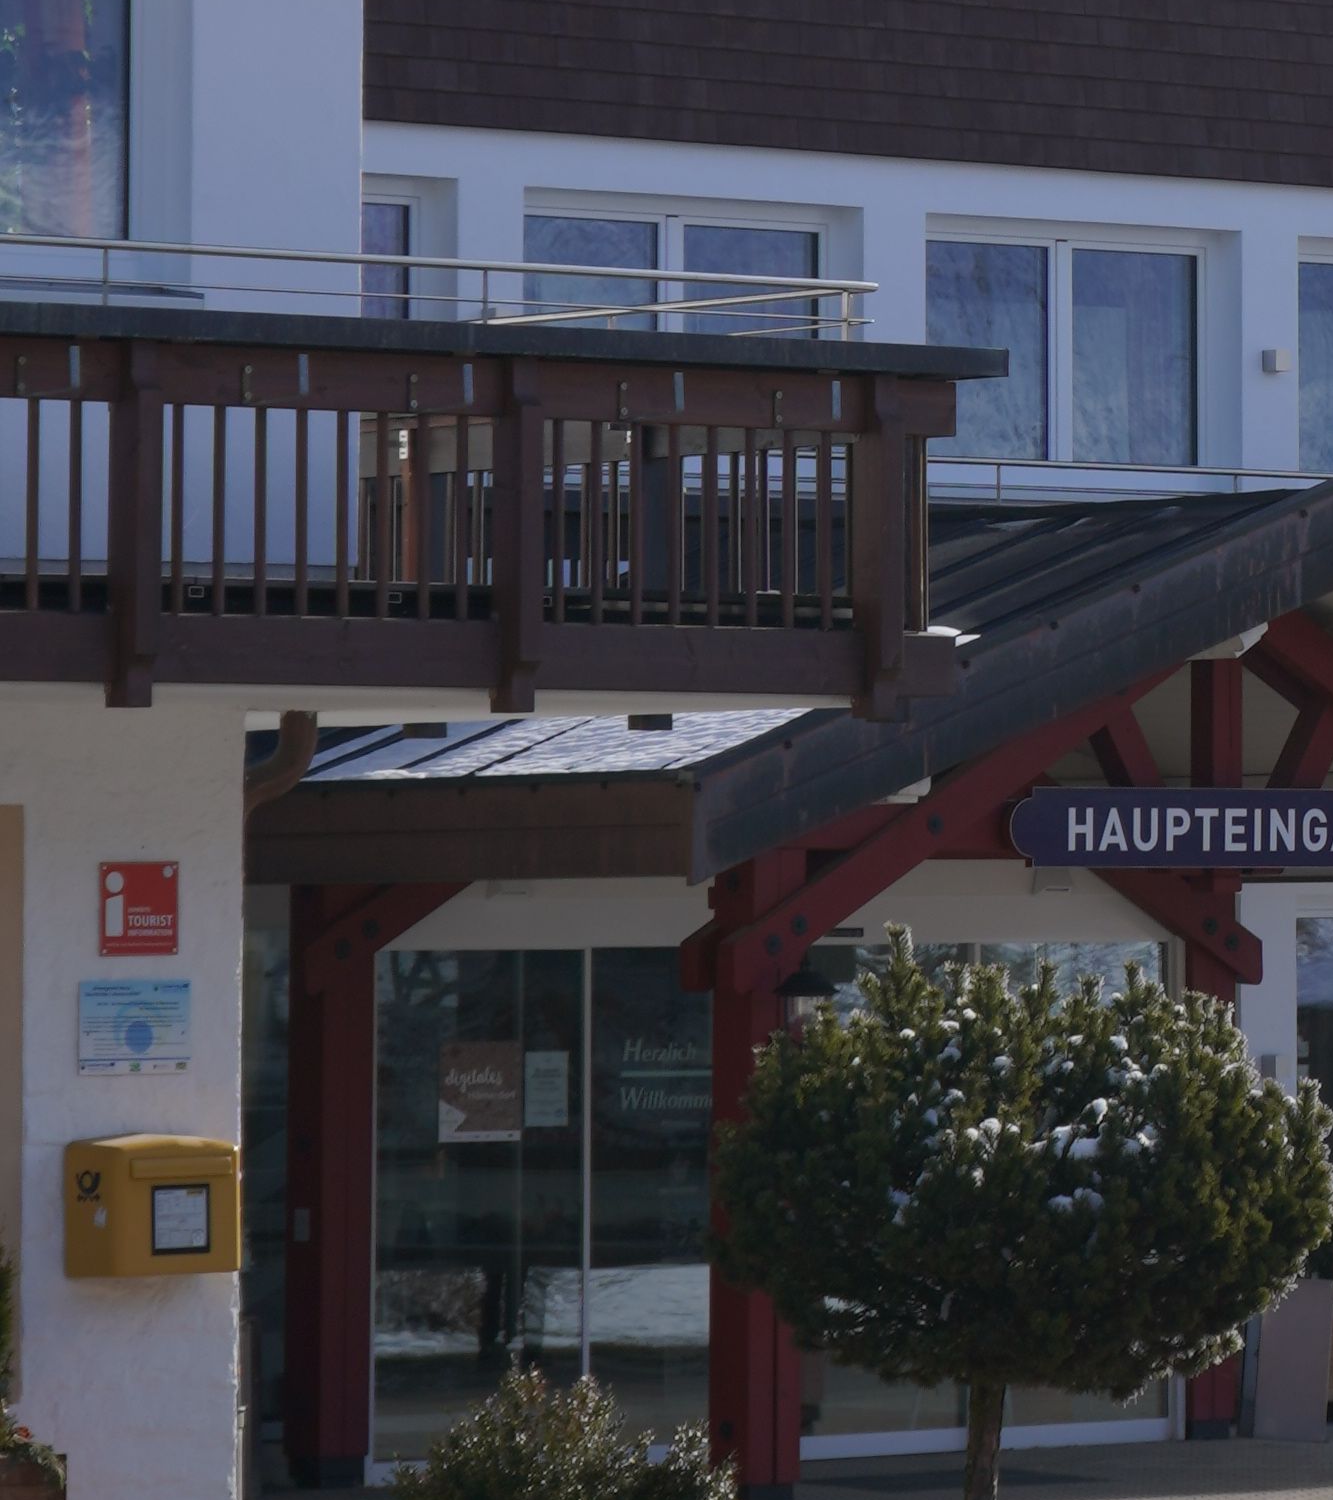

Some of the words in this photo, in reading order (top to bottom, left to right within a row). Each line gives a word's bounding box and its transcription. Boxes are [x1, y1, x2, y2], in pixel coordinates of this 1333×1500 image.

[127, 914, 173, 927] TOURIST
[622, 1038, 698, 1062] Herzlich
[444, 1066, 503, 1093] digitales
[620, 1086, 713, 1111] Willkomm
